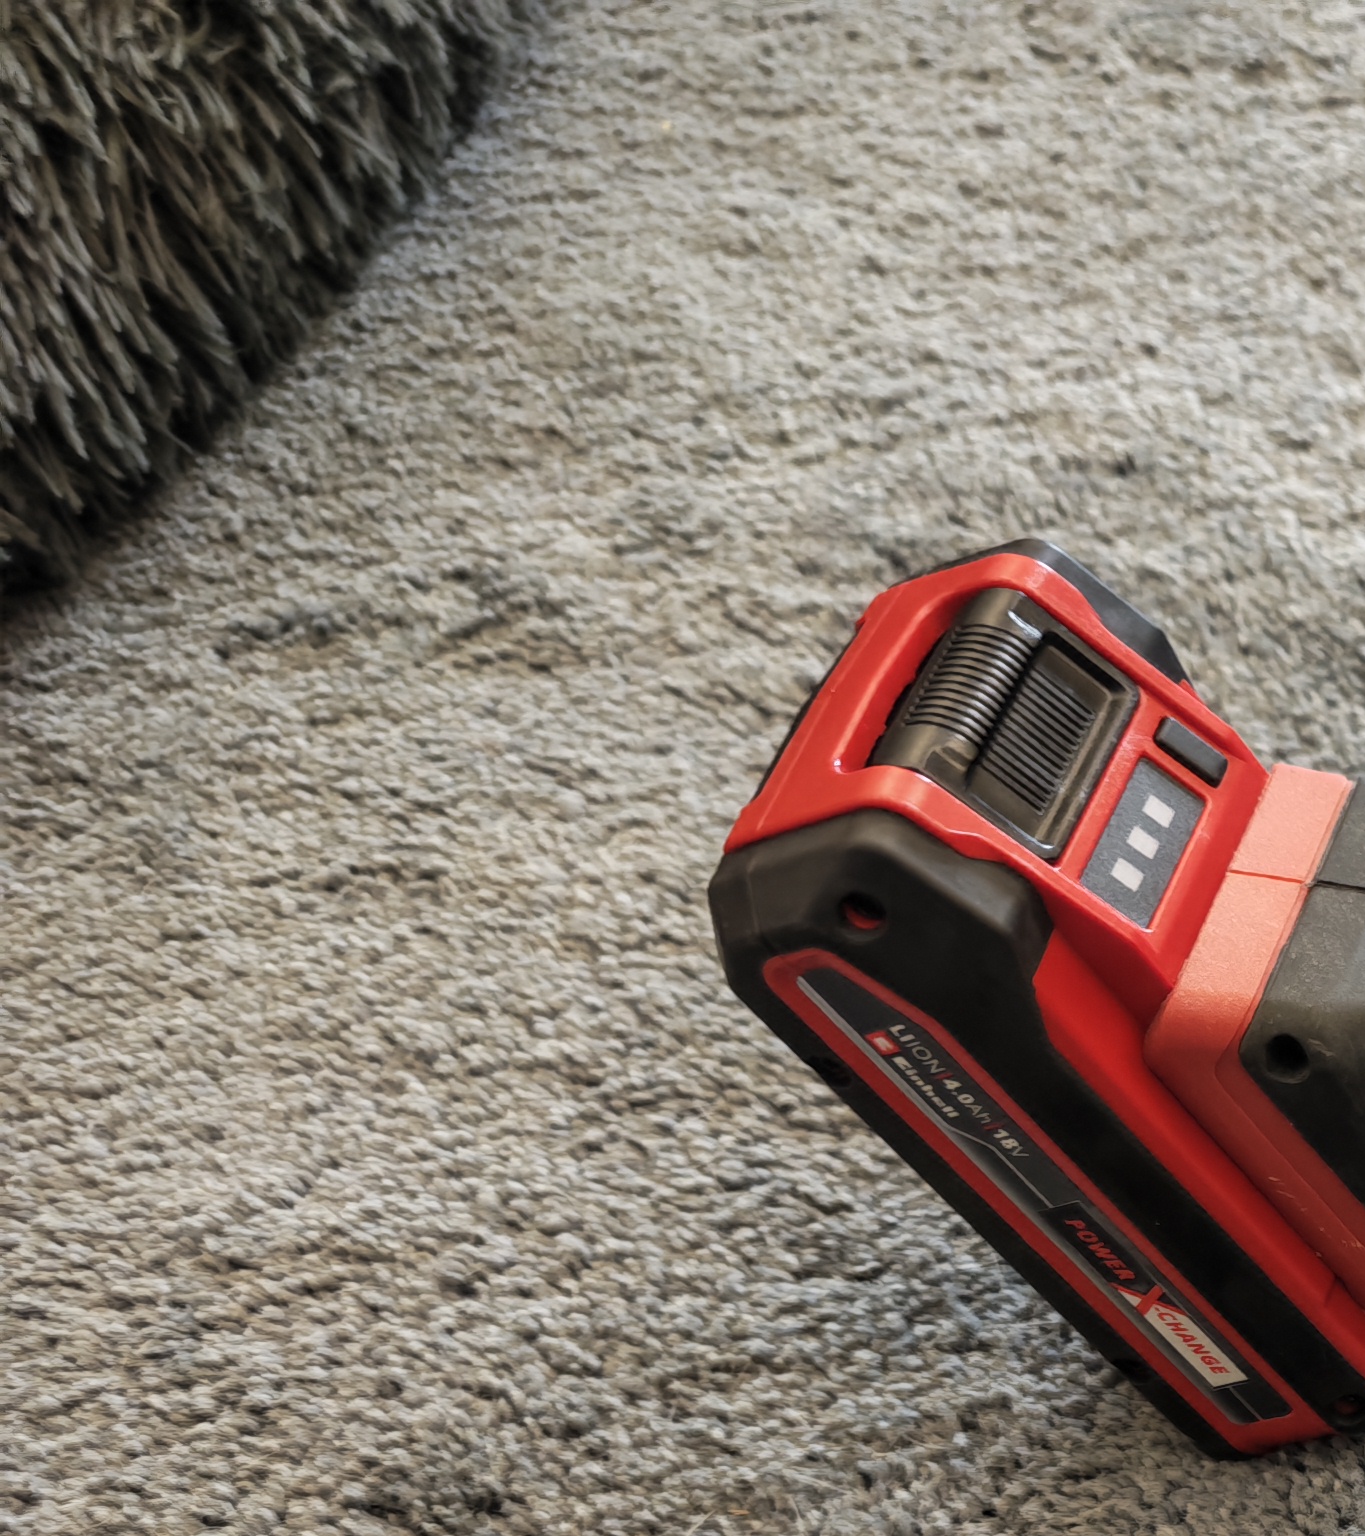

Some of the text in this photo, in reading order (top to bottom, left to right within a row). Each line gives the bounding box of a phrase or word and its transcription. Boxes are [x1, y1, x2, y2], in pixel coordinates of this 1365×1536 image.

[891, 1056, 960, 1118] Einhell
[942, 1078, 992, 1124] 4.0Ah
[993, 1128, 1030, 1157] 18V
[1064, 1219, 1135, 1280] POWER
